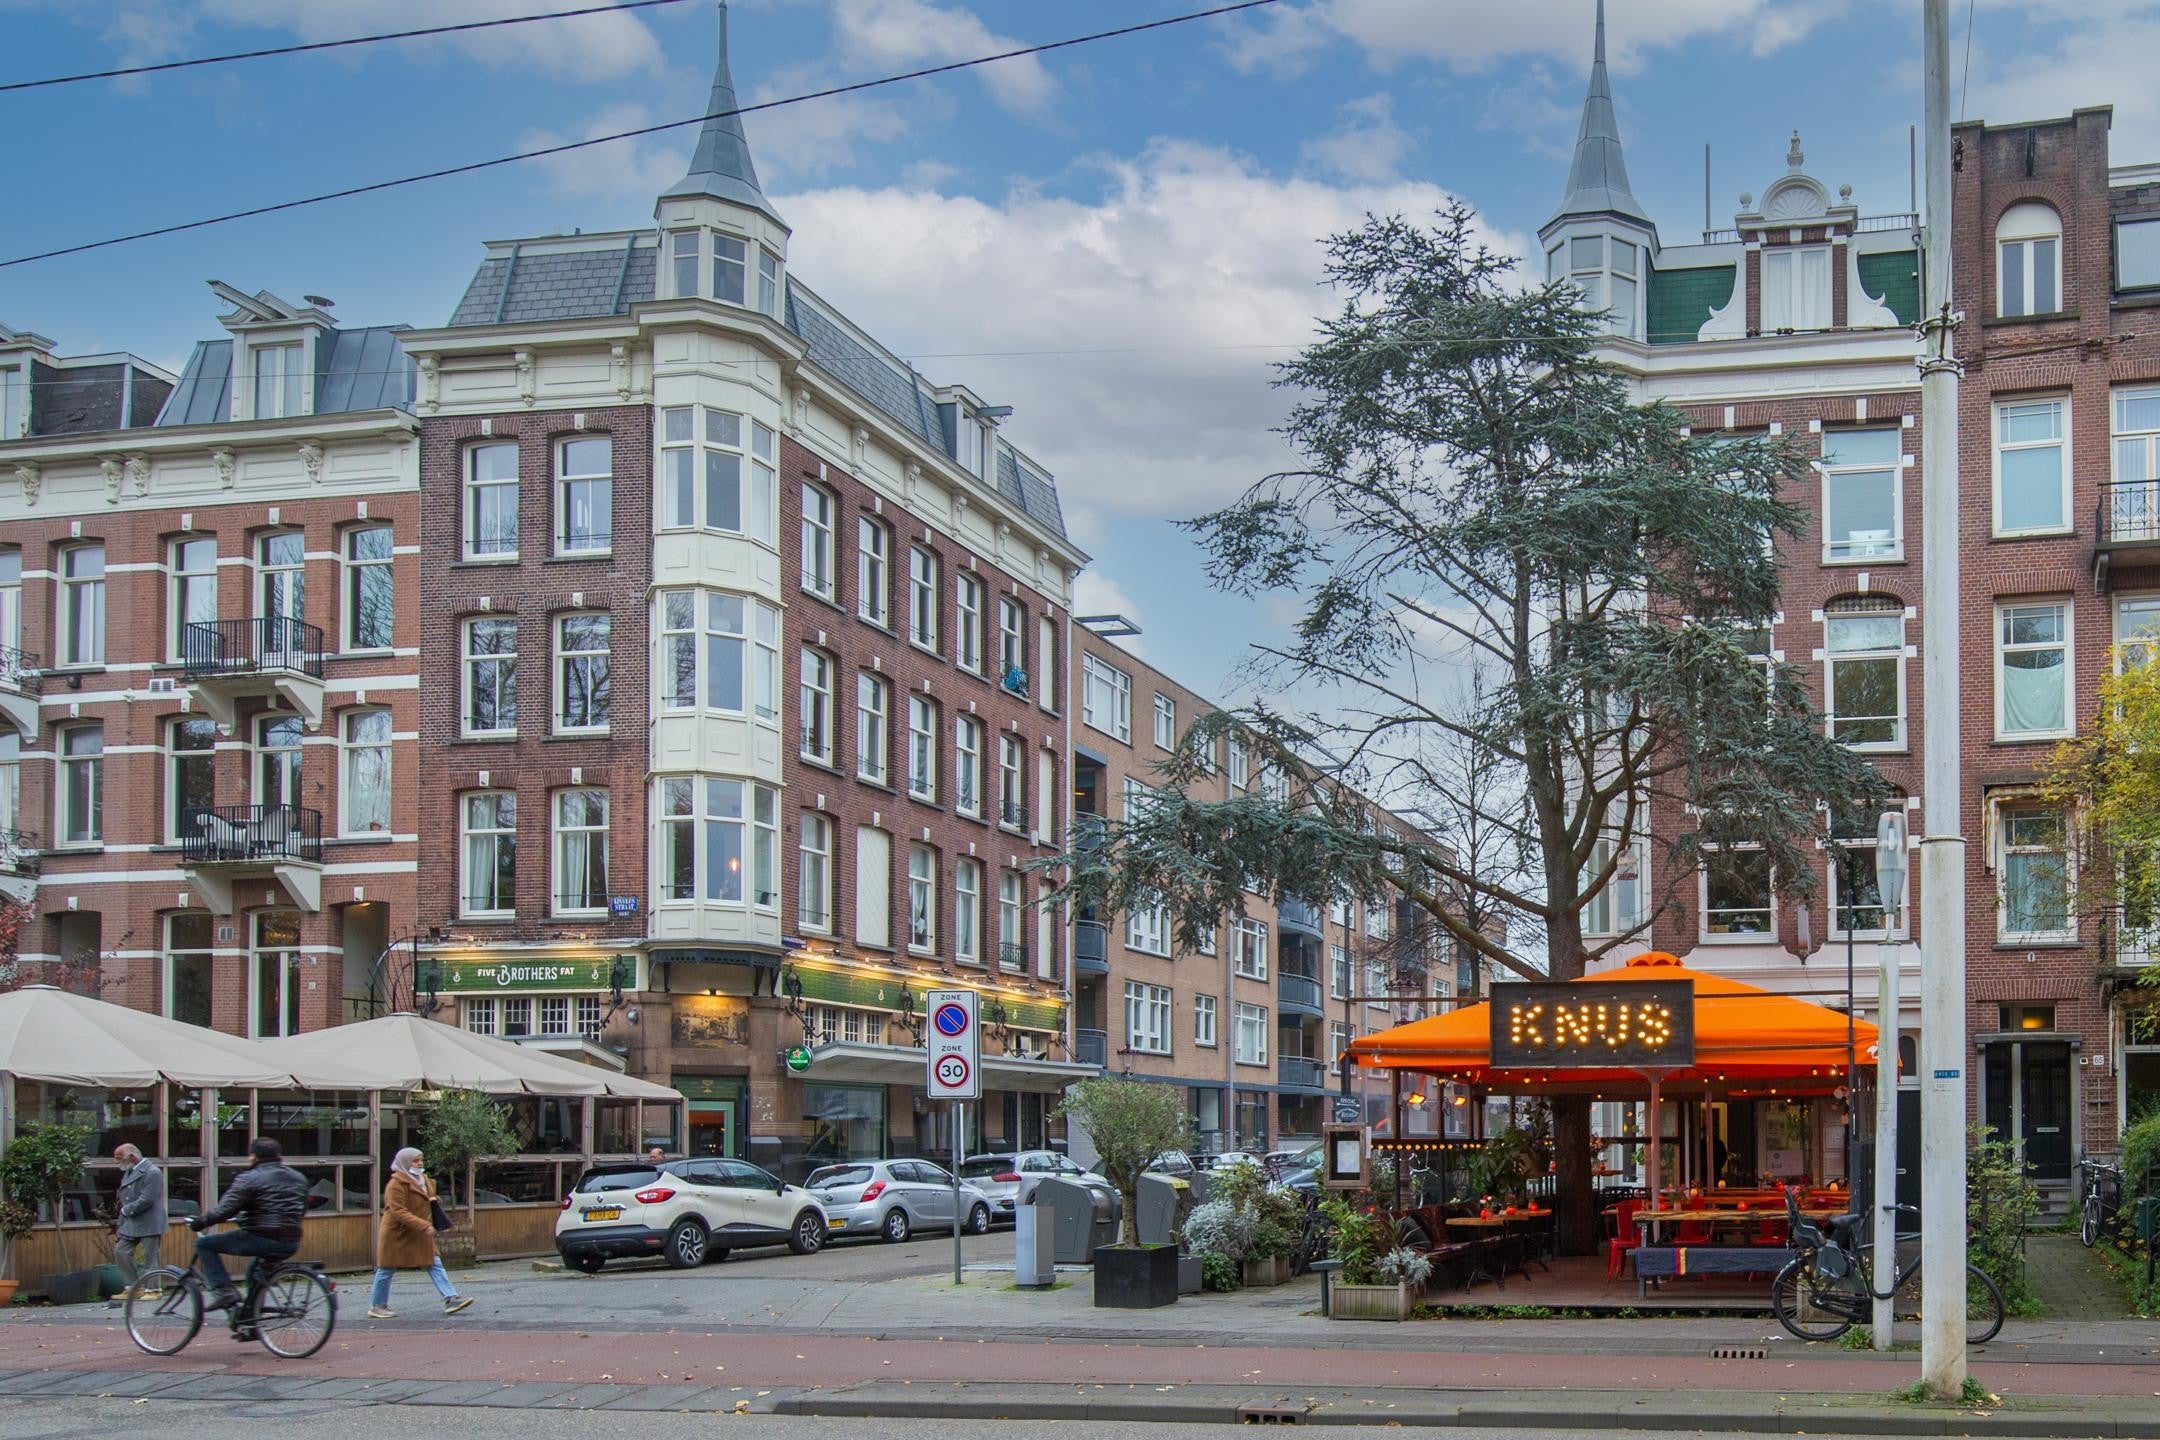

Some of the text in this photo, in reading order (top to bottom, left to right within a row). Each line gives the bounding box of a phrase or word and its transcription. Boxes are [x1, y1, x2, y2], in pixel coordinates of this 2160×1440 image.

[477, 965, 575, 985] FIVE BROTHERS FAT
[1511, 1003, 1671, 1046] KNUS
[941, 1064, 964, 1078] 30
